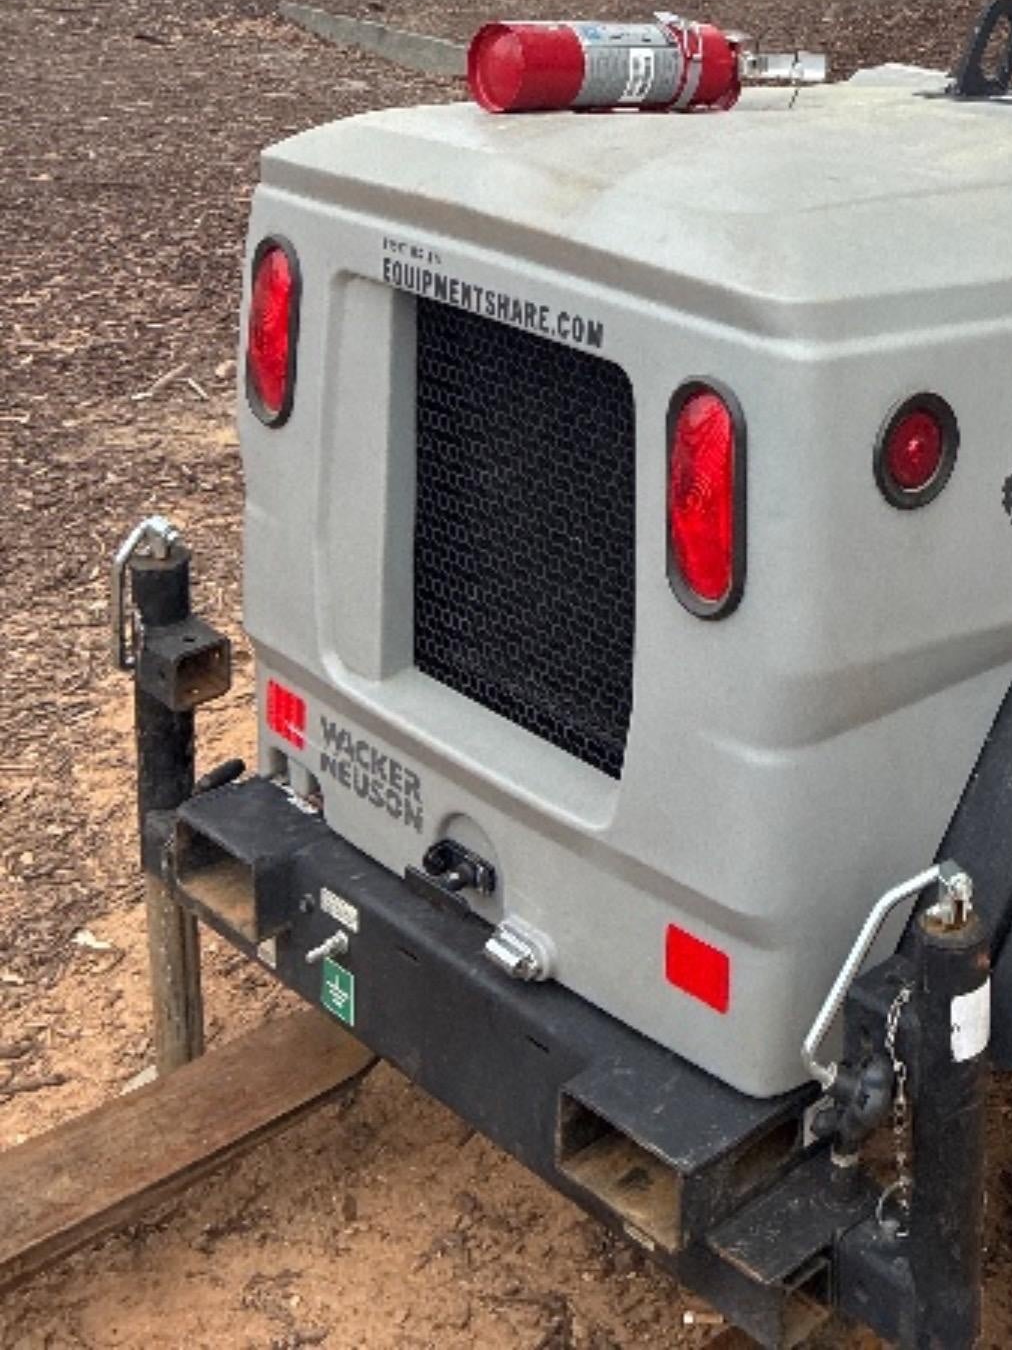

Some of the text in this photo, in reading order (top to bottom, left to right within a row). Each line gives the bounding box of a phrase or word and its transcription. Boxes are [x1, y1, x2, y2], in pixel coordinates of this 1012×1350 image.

[382, 257, 604, 348] EQUIPMENTSHARE.COM
[320, 716, 423, 803] WACKER
[320, 753, 423, 833] NEUSON
